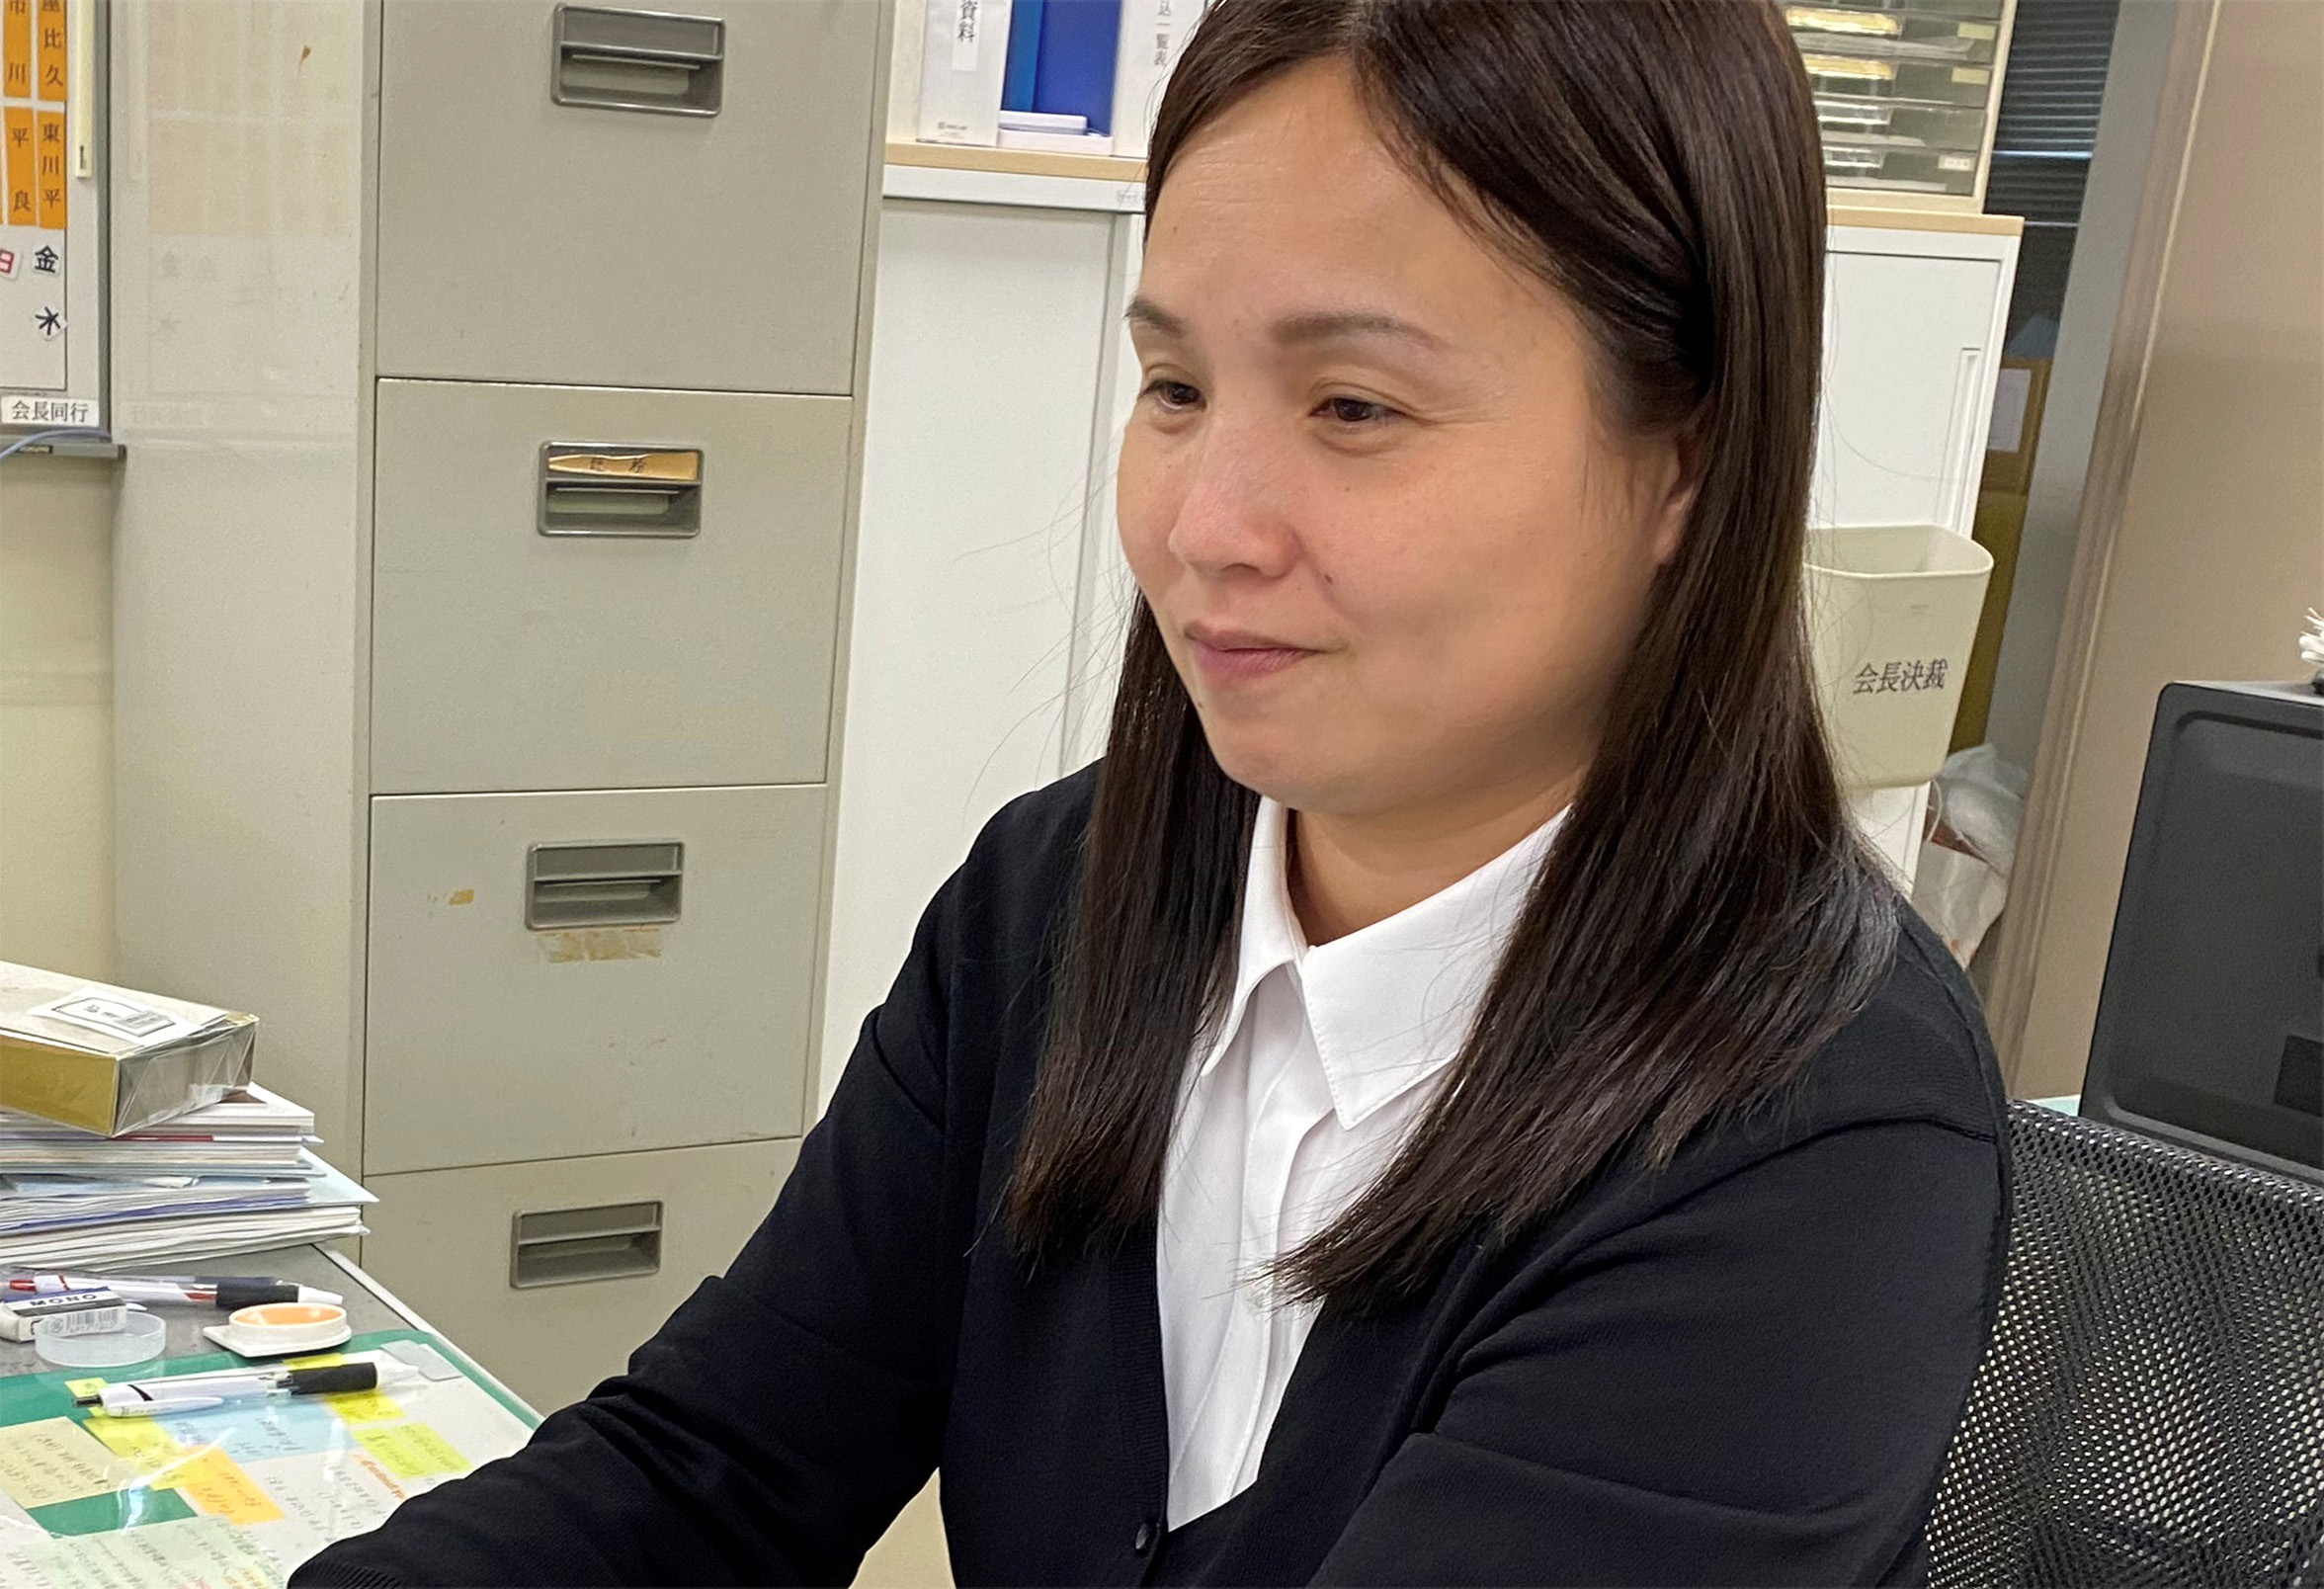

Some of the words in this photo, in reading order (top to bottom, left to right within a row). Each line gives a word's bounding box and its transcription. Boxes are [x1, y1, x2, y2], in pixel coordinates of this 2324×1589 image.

[12, 127, 31, 211] 平良
[42, 124, 61, 209] 東川平
[35, 245, 58, 274] 金
[35, 306, 60, 335] 木
[12, 399, 89, 423] 会長同行
[1853, 658, 1949, 695] 会長決裁
[30, 1294, 97, 1306] MONO
